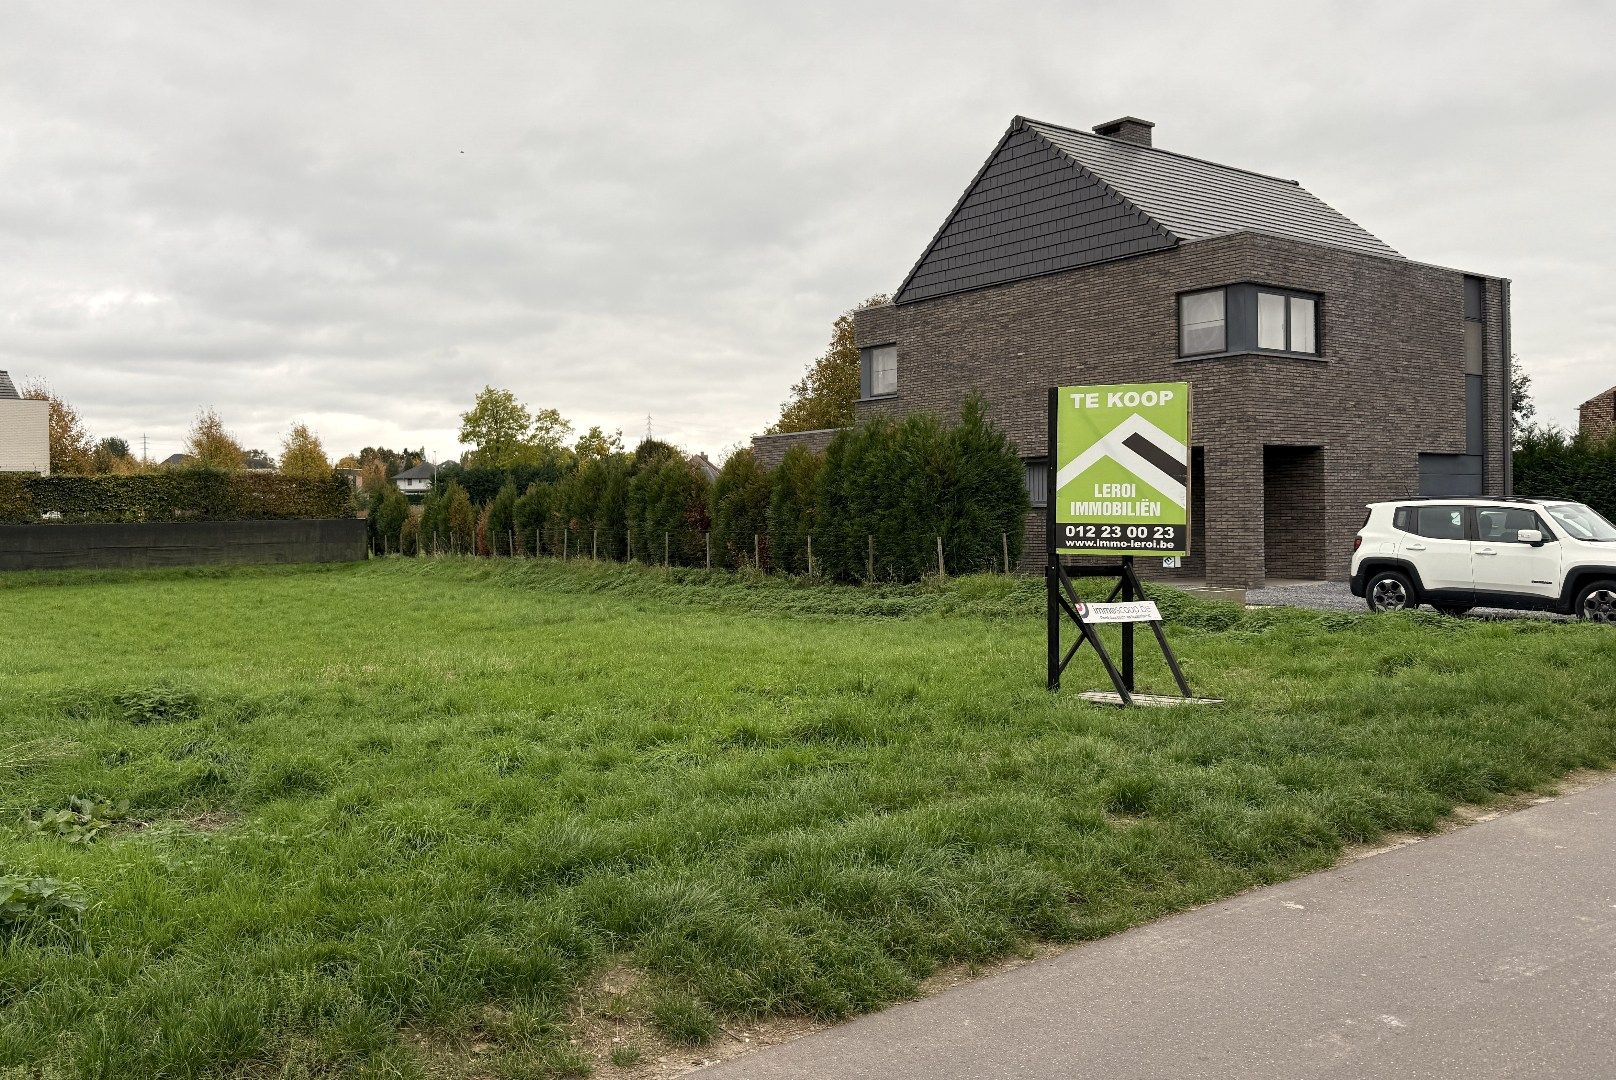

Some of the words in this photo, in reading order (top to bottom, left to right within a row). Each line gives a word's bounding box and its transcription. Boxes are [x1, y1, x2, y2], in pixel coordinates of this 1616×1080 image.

[1070, 393, 1099, 408] TE
[1107, 390, 1174, 407] KOOP
[1094, 483, 1136, 498] LEROI
[1070, 498, 1161, 516] IMMOBILIËN
[1065, 525, 1096, 537] 012
[1100, 526, 1121, 538] 23
[1126, 526, 1148, 538] 00
[1153, 526, 1175, 539] 23
[1065, 538, 1175, 549] www.immo-leroi.be
